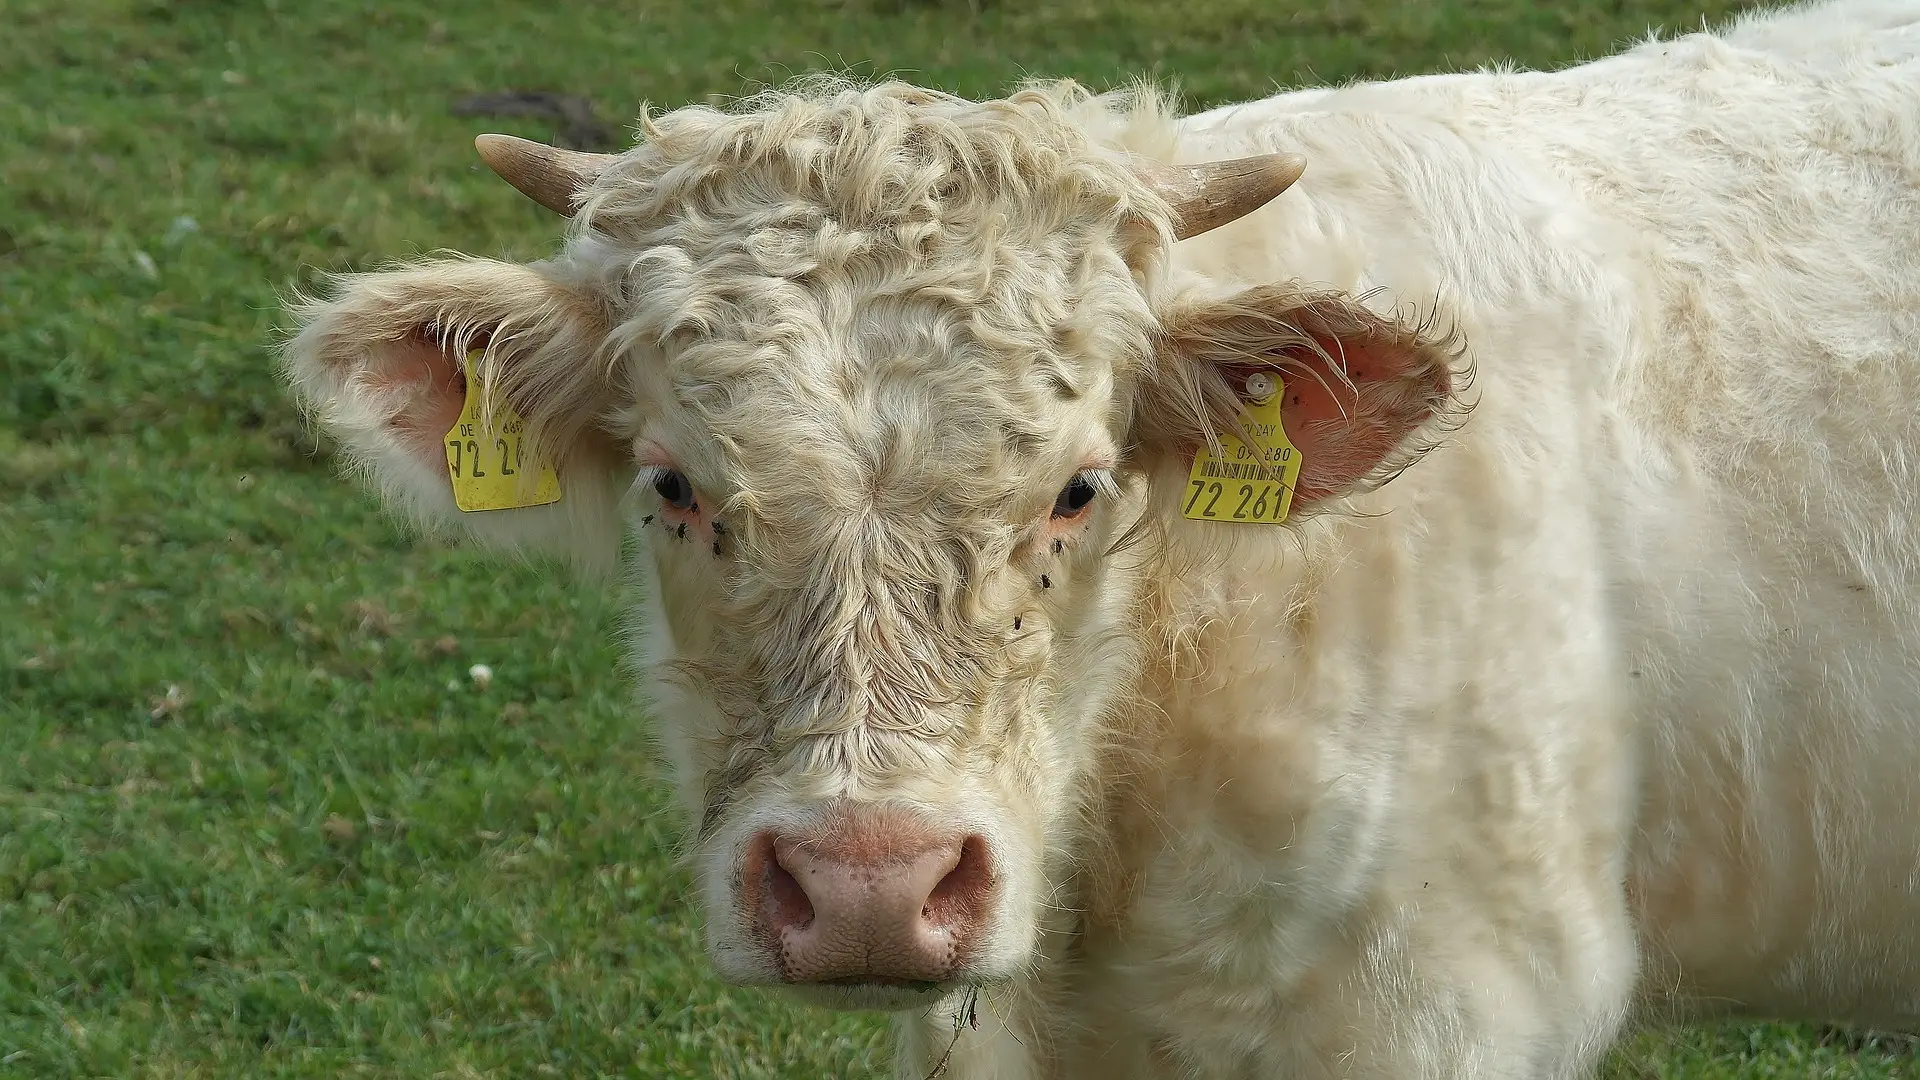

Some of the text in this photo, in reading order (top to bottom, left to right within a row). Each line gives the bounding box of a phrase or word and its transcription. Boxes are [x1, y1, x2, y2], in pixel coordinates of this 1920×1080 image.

[460, 423, 475, 437] DE
[449, 440, 486, 479] 72
[1184, 480, 1286, 520] 72 261
